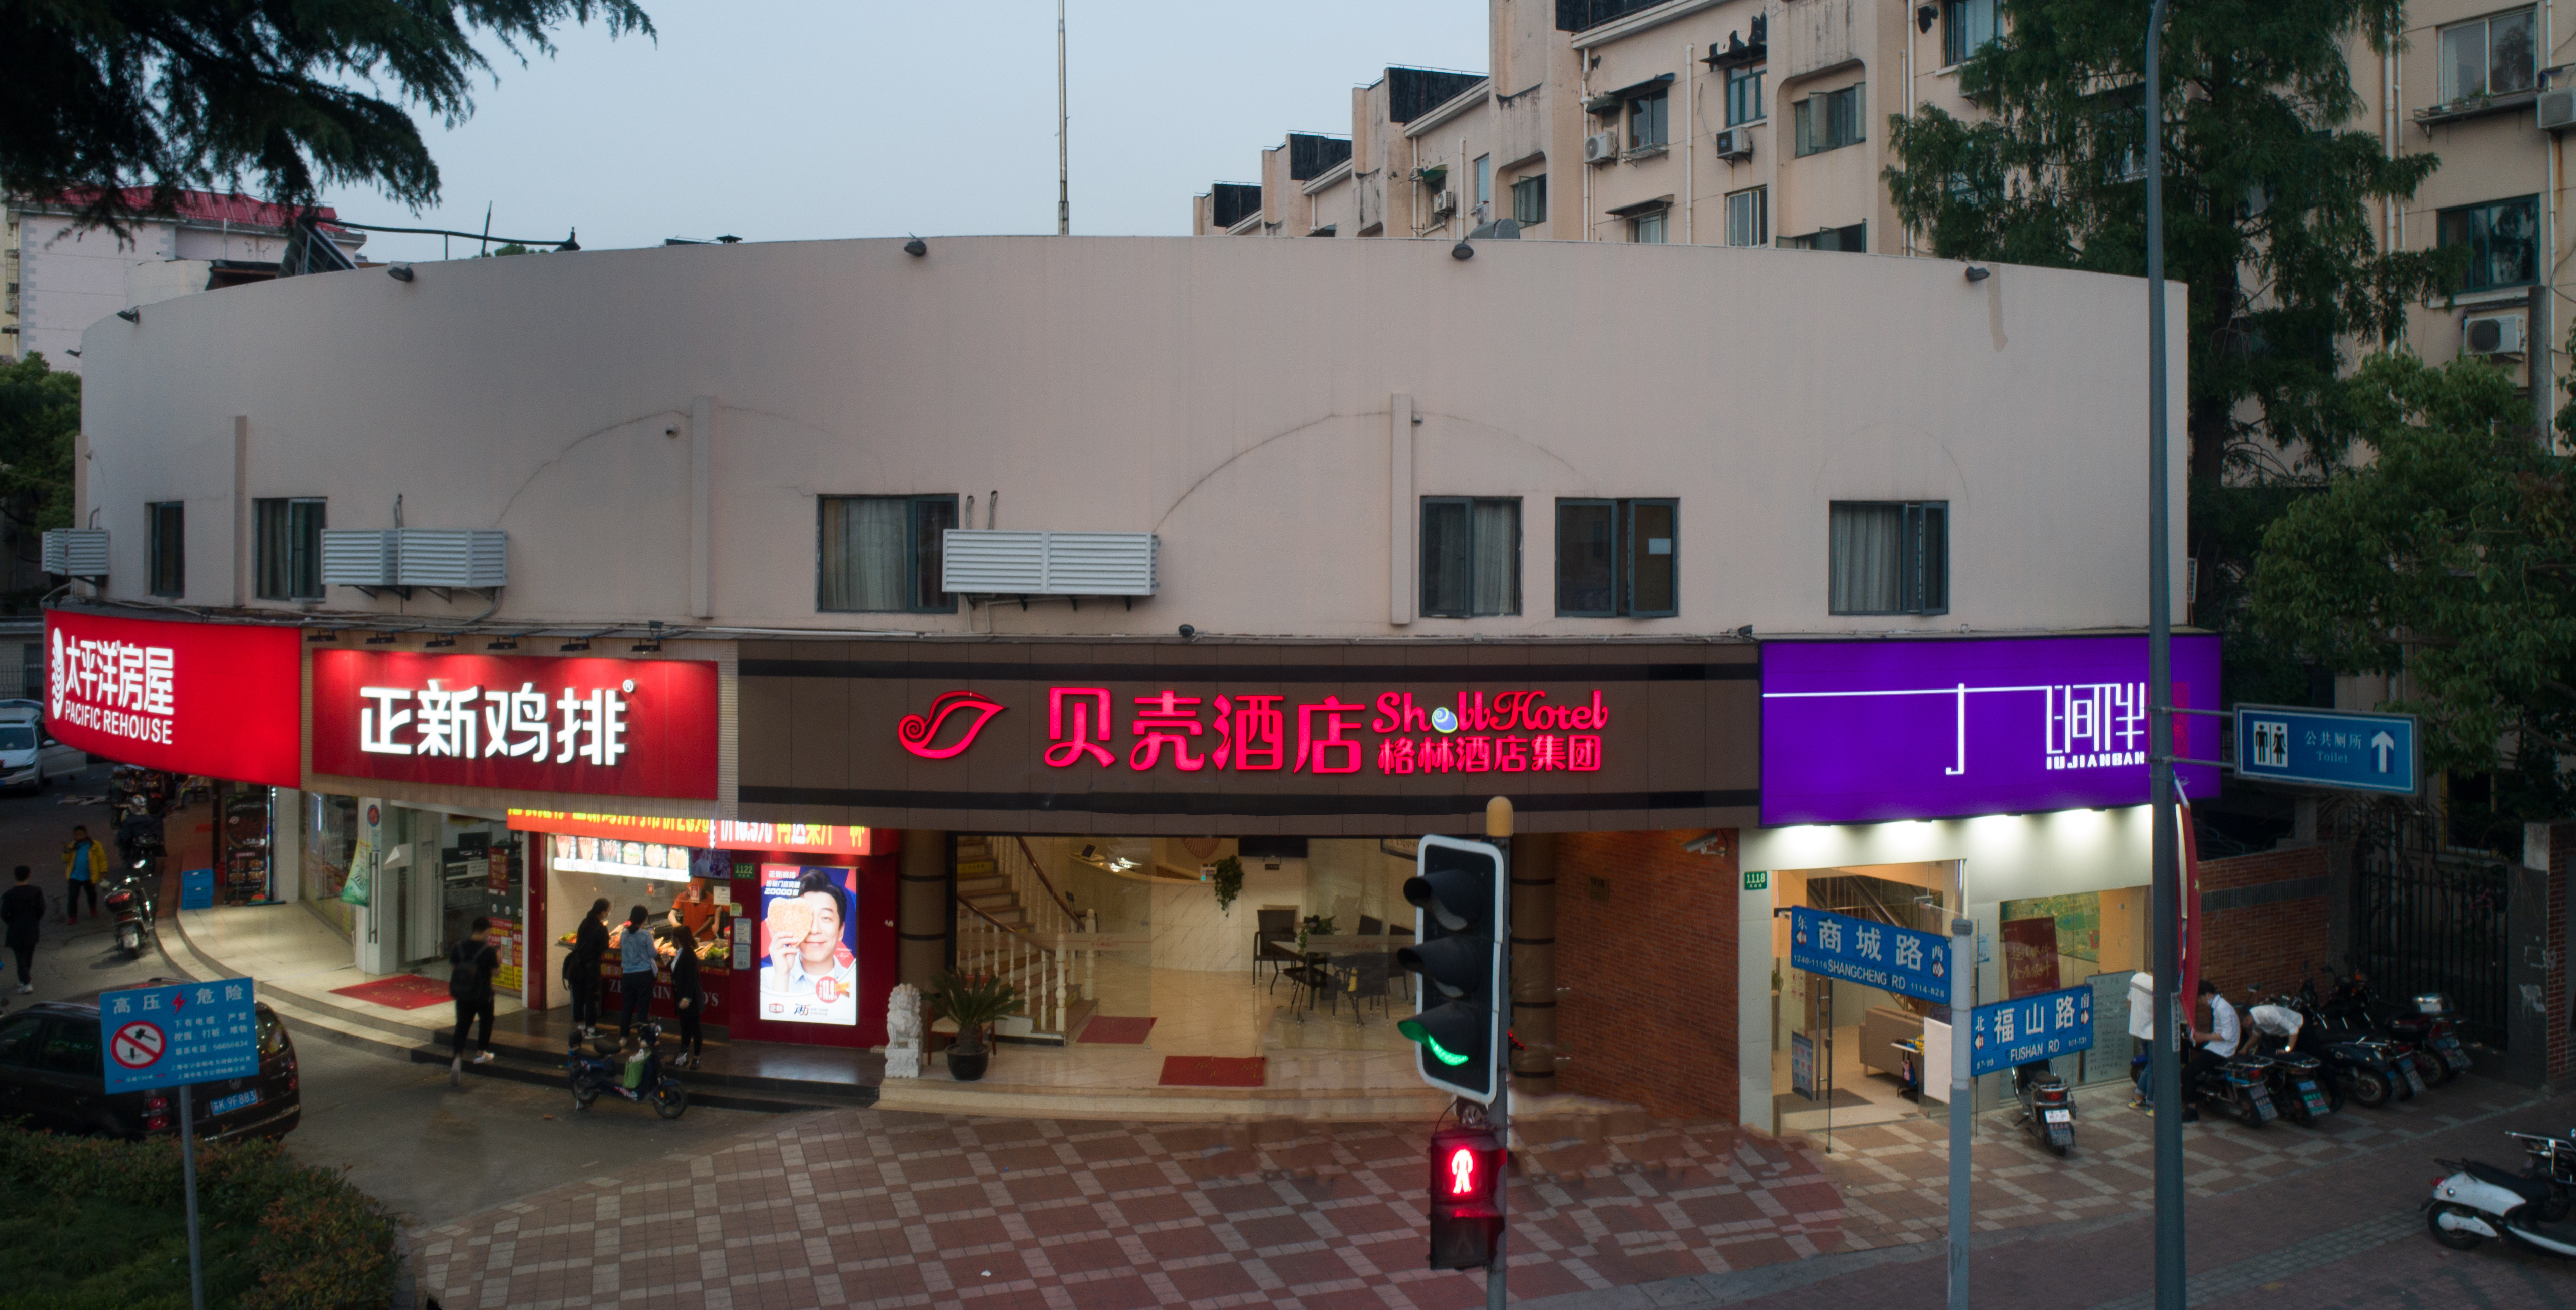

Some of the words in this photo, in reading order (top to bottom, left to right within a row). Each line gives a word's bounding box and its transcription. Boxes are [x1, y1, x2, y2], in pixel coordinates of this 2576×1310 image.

[66, 635, 173, 715] 太平洋房屋
[65, 699, 101, 730] PACIFIC
[103, 709, 172, 744] REHOUSE
[1045, 686, 1367, 774] 贝壳酒店
[2304, 730, 2362, 750] 公共厕所
[1378, 734, 1601, 775] 格林酒店集团
[2316, 751, 2348, 763] Toilet
[735, 865, 753, 874] 1122
[1746, 873, 1766, 884] 1118
[1798, 915, 1808, 930] 东
[1818, 919, 1923, 971] 商城路
[1932, 945, 1943, 962] 西
[1828, 959, 1887, 986] SHANGCHENG
[1892, 974, 1906, 990] RD
[1910, 983, 1944, 998] 1114-828
[112, 994, 161, 1014] 高压
[196, 984, 243, 1004] 危险
[1975, 1016, 1985, 1031] 北
[1994, 995, 2075, 1044] 福山路
[2011, 1042, 2044, 1062] FUSHAN
[2048, 1039, 2060, 1053] RD
